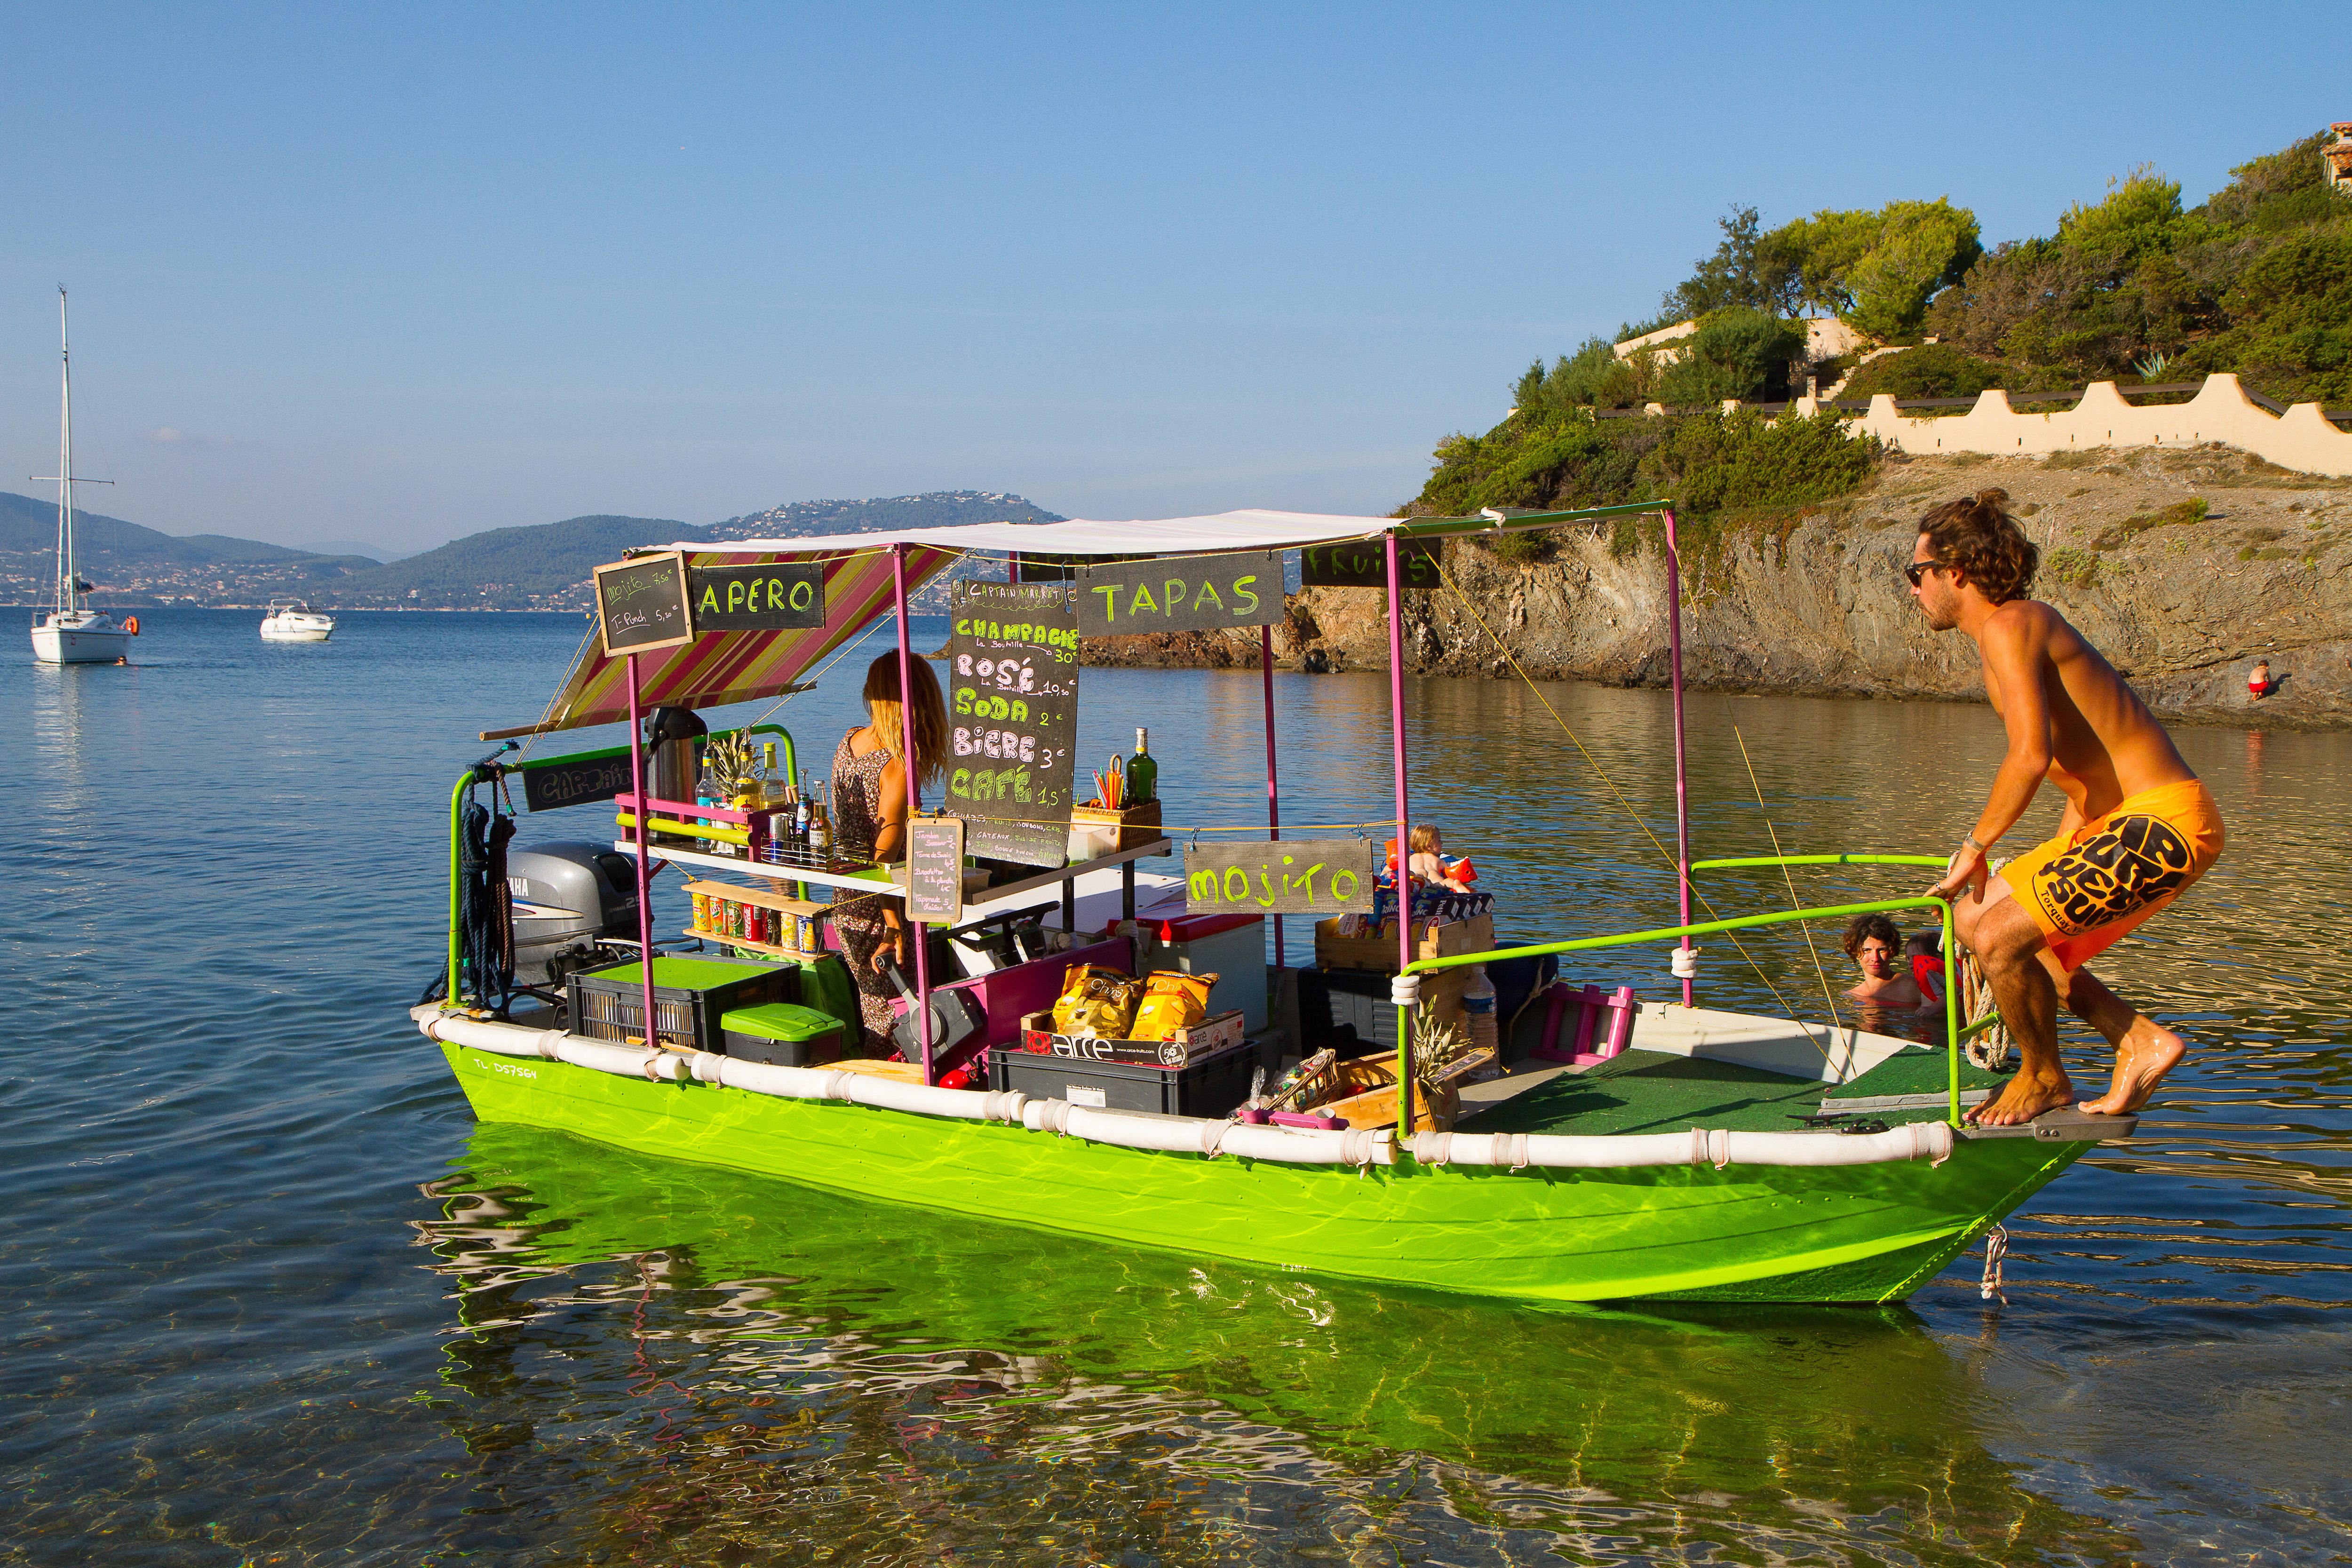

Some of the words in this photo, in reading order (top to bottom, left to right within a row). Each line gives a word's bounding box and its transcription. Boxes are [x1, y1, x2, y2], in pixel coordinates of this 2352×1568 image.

[699, 578, 813, 615] APERO
[1020, 589, 1058, 599] MARKET
[1091, 575, 1259, 622] TAPAS
[955, 619, 1079, 650] CHAMPAGNE
[976, 637, 985, 647] La
[951, 764, 1032, 803] CAFÉ
[915, 830, 939, 839] Jambon
[1435, 899, 1446, 915] Petit
[2041, 890, 2071, 931] Torquay,
[1091, 979, 1123, 998] Chips
[473, 1059, 488, 1069] TL
